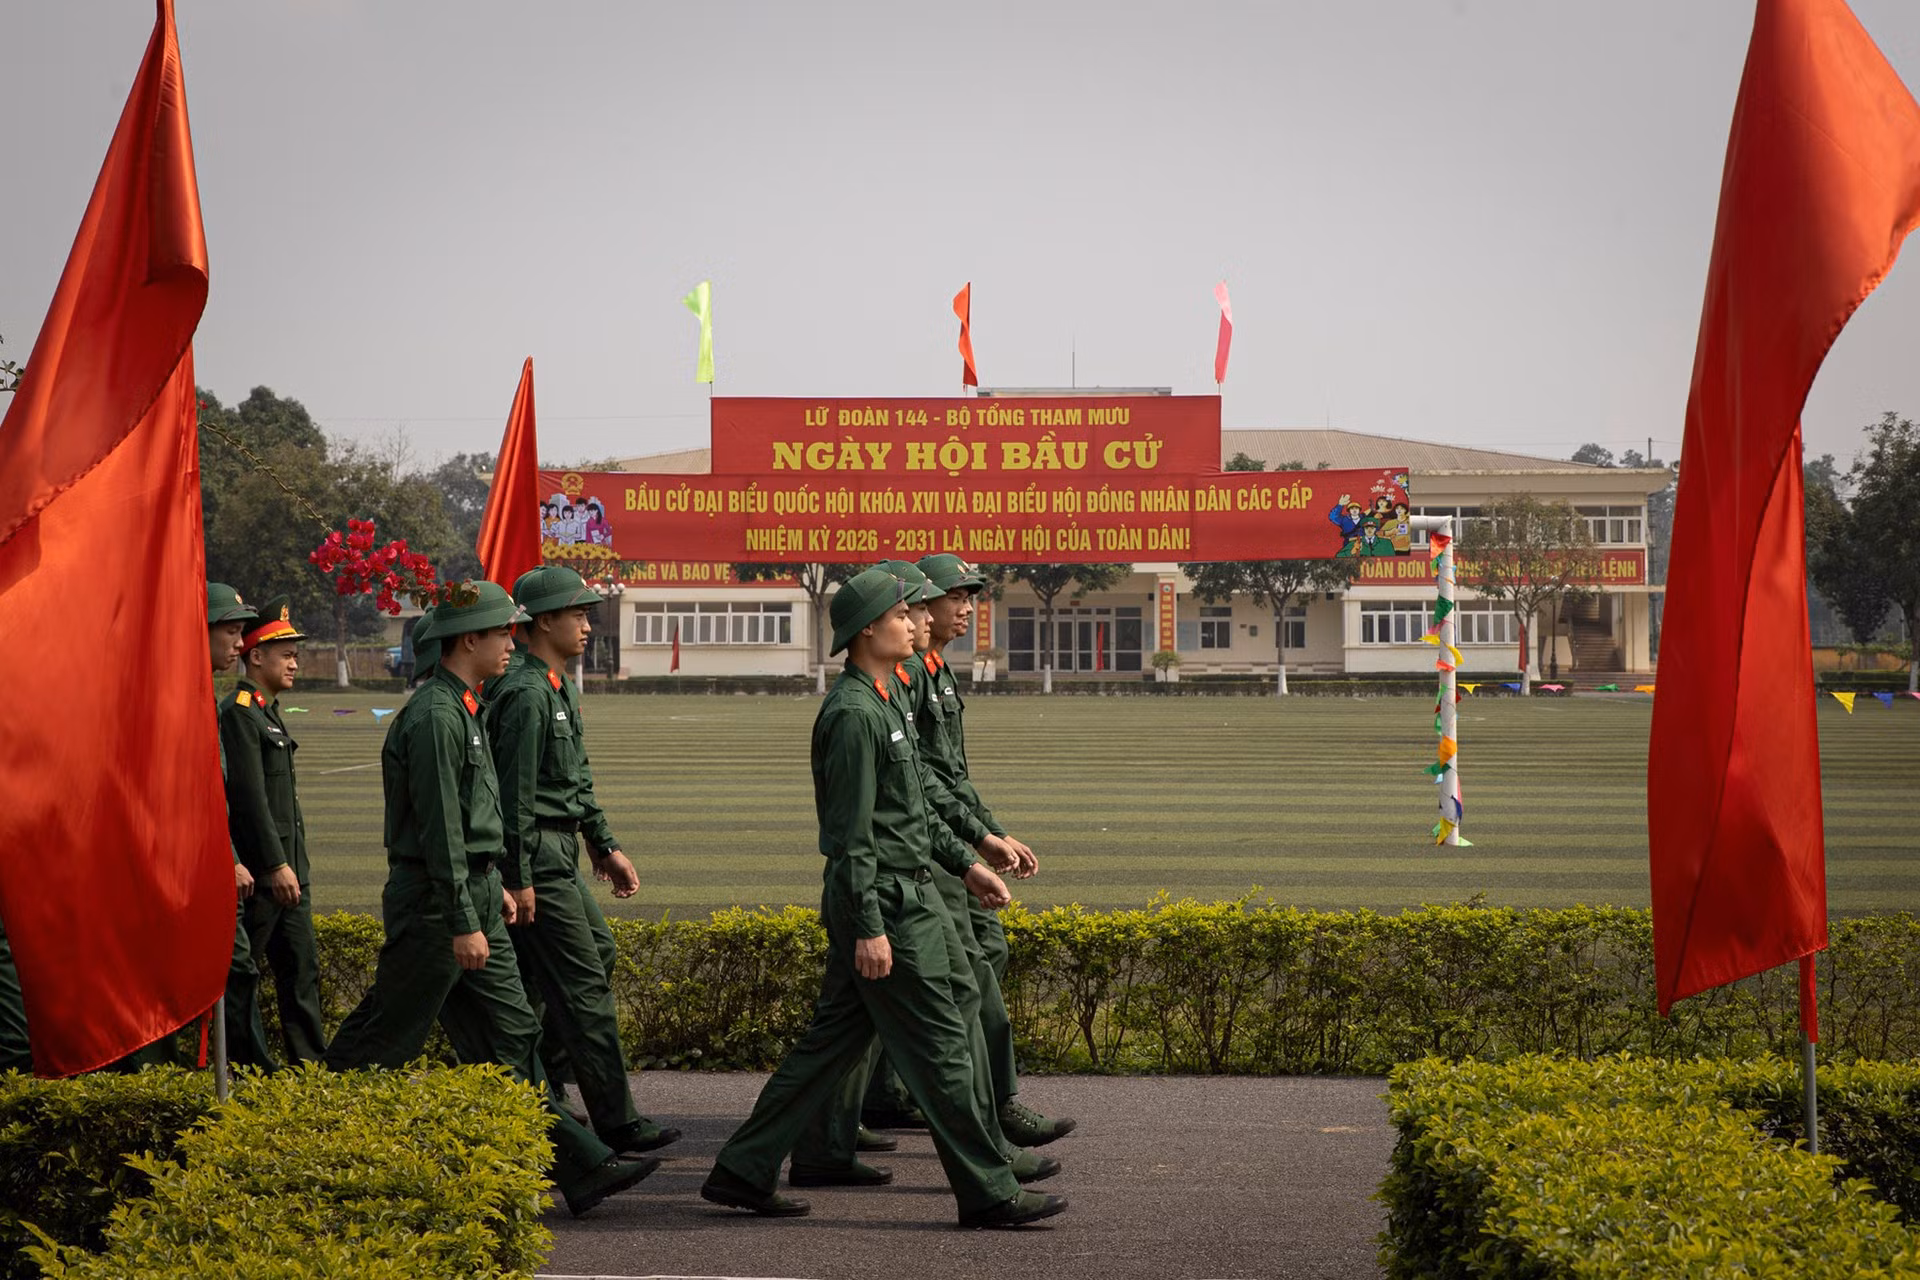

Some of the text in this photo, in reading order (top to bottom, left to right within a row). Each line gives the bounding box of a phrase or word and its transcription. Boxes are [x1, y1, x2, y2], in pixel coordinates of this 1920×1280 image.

[804, 406, 830, 427] LỮ
[838, 406, 889, 427] ĐOÀN
[895, 409, 929, 427] 144
[946, 405, 971, 430] BỘ
[976, 402, 1025, 427] TỔNG
[1030, 408, 1082, 427] THAM
[1087, 406, 1130, 426] MƯU
[772, 431, 1163, 477] NGÀY HỘI BẦU CỬ
[625, 480, 1313, 519] BẦU CỬ ĐẠI BIỂU QUỐC HỘI KHÓA XVI VÀ ĐẠI BIỂU HỘI ĐỒNG NHÂN DÂN CÁC CẤP
[746, 526, 803, 556] NHIỆM
[808, 526, 831, 552] KỲ
[835, 530, 879, 552] 2026
[895, 530, 939, 552] 2031
[943, 525, 965, 551] LÀ
[969, 524, 1016, 551] NGÀY
[1021, 525, 1051, 556] HỘI
[1056, 524, 1092, 551] CỦA
[1097, 524, 1143, 551] TOÀN
[1147, 523, 1191, 550] DÂN!
[1397, 559, 1426, 578] ĐƠN
[1602, 557, 1637, 581] LỆNH
